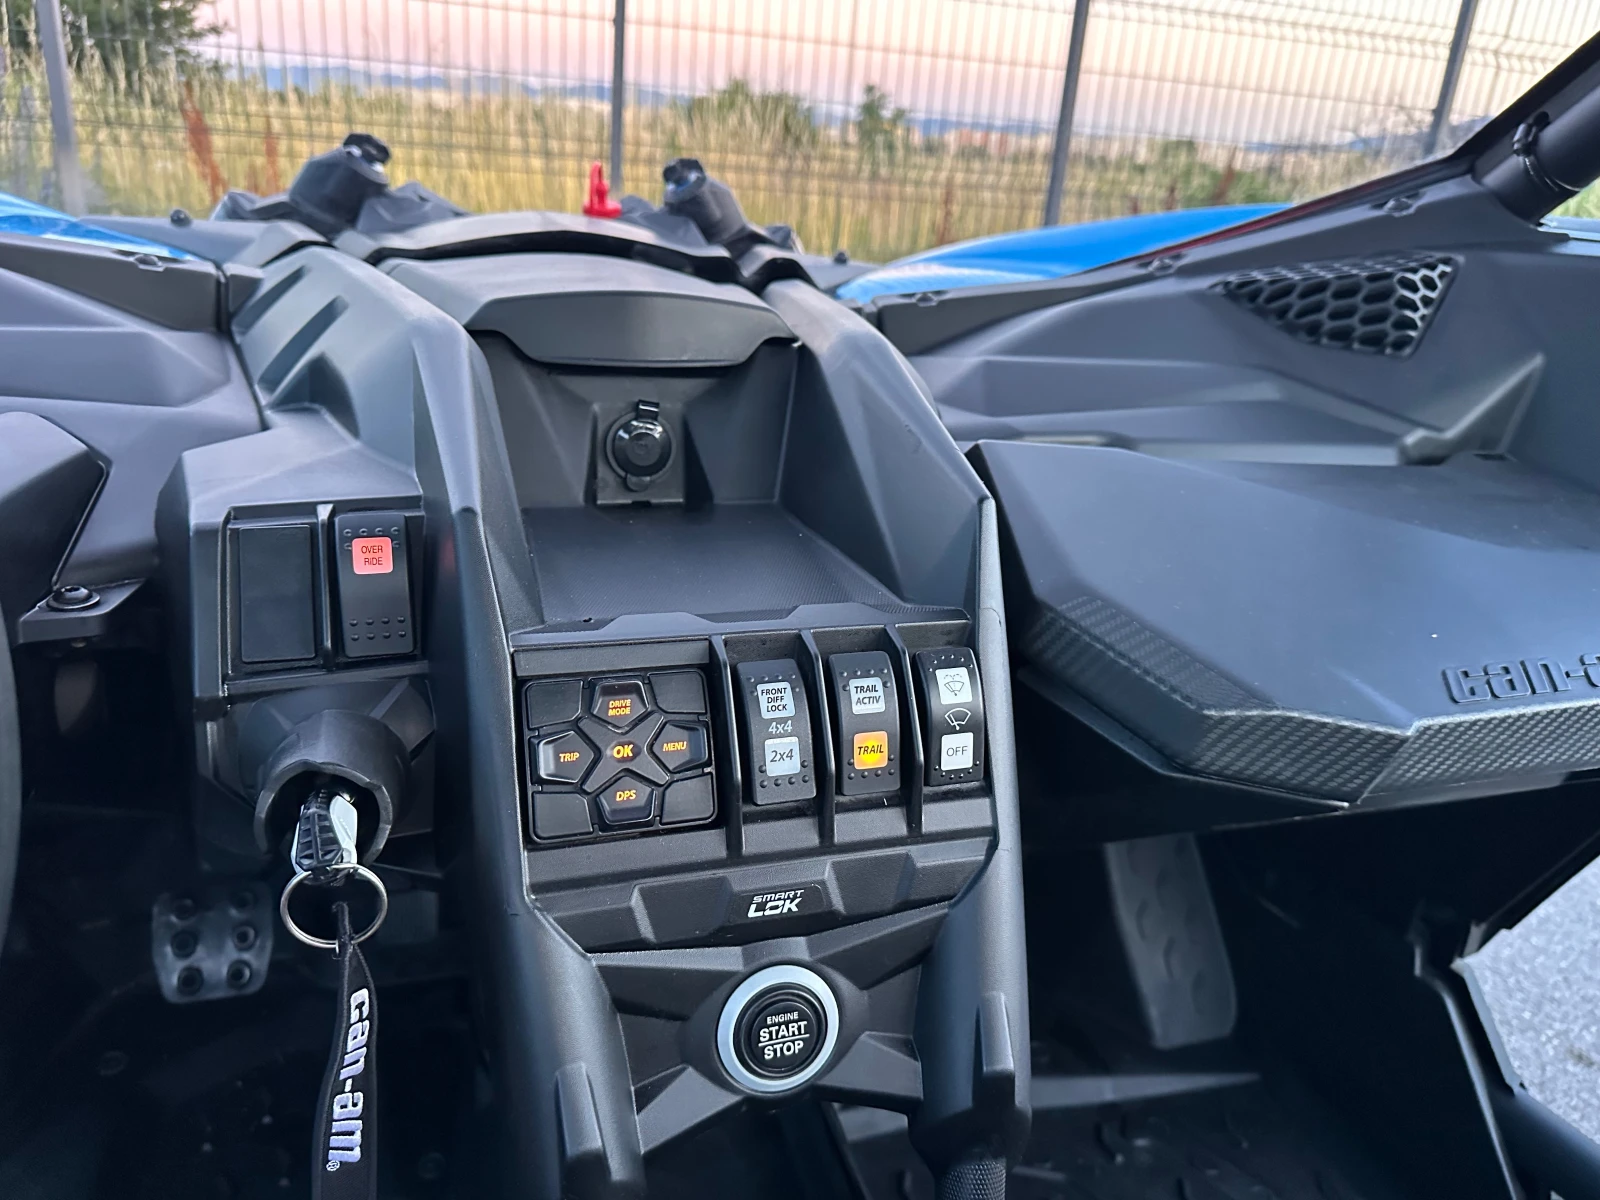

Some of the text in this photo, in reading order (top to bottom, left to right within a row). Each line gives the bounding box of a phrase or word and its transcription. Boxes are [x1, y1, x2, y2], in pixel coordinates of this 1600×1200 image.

[361, 545, 384, 554] OVER
[364, 557, 383, 566] RIDE
[760, 687, 787, 696] FRONT
[854, 685, 879, 695] TRAIL
[608, 699, 631, 708] DRIVE
[766, 695, 785, 704] DIFF
[855, 696, 882, 706] ACTIV
[608, 706, 631, 716] MODE
[766, 703, 788, 713] LOCK
[768, 720, 792, 734] 4x4
[613, 744, 633, 758] OK
[662, 741, 687, 752] MENU
[857, 745, 885, 757] TRAIL
[946, 745, 968, 758] OFF
[559, 752, 579, 762] TRIP
[769, 749, 794, 764] 2x4
[616, 789, 637, 802] DPS
[752, 889, 805, 904] SMART
[747, 898, 802, 918] LOK
[766, 1011, 799, 1025] ENGINE
[759, 1021, 807, 1042] START
[763, 1040, 804, 1061] STOP
[327, 987, 370, 1163] can-am
